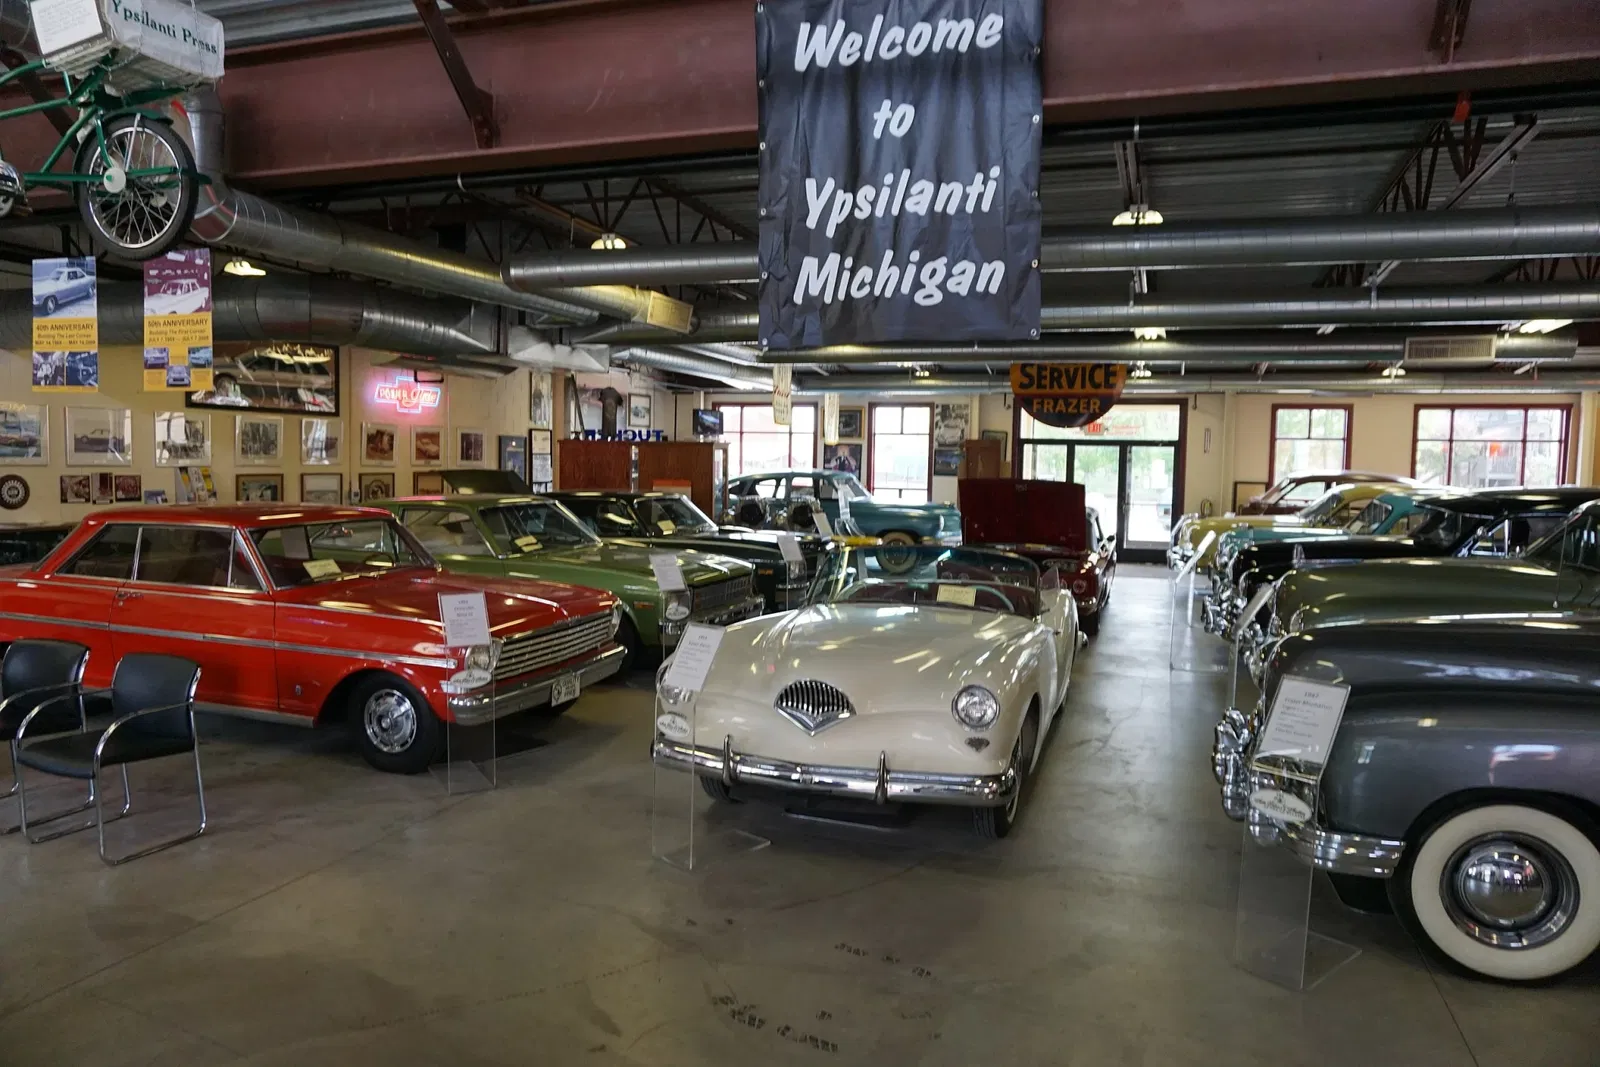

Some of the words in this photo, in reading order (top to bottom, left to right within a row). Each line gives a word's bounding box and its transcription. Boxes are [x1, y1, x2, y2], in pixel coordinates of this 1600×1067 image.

[111, 0, 177, 39] Ypsilanti
[181, 27, 218, 55] Press
[794, 13, 1004, 72] Welcome
[873, 99, 915, 139] to
[805, 165, 1000, 238] Ypsilanti
[793, 249, 1005, 306] Michigan
[50, 323, 94, 331] ANNIVERSARY
[162, 318, 208, 327] ANNIVERSARY
[1018, 363, 1118, 389] SERVICE
[1032, 398, 1101, 413] FRAZER
